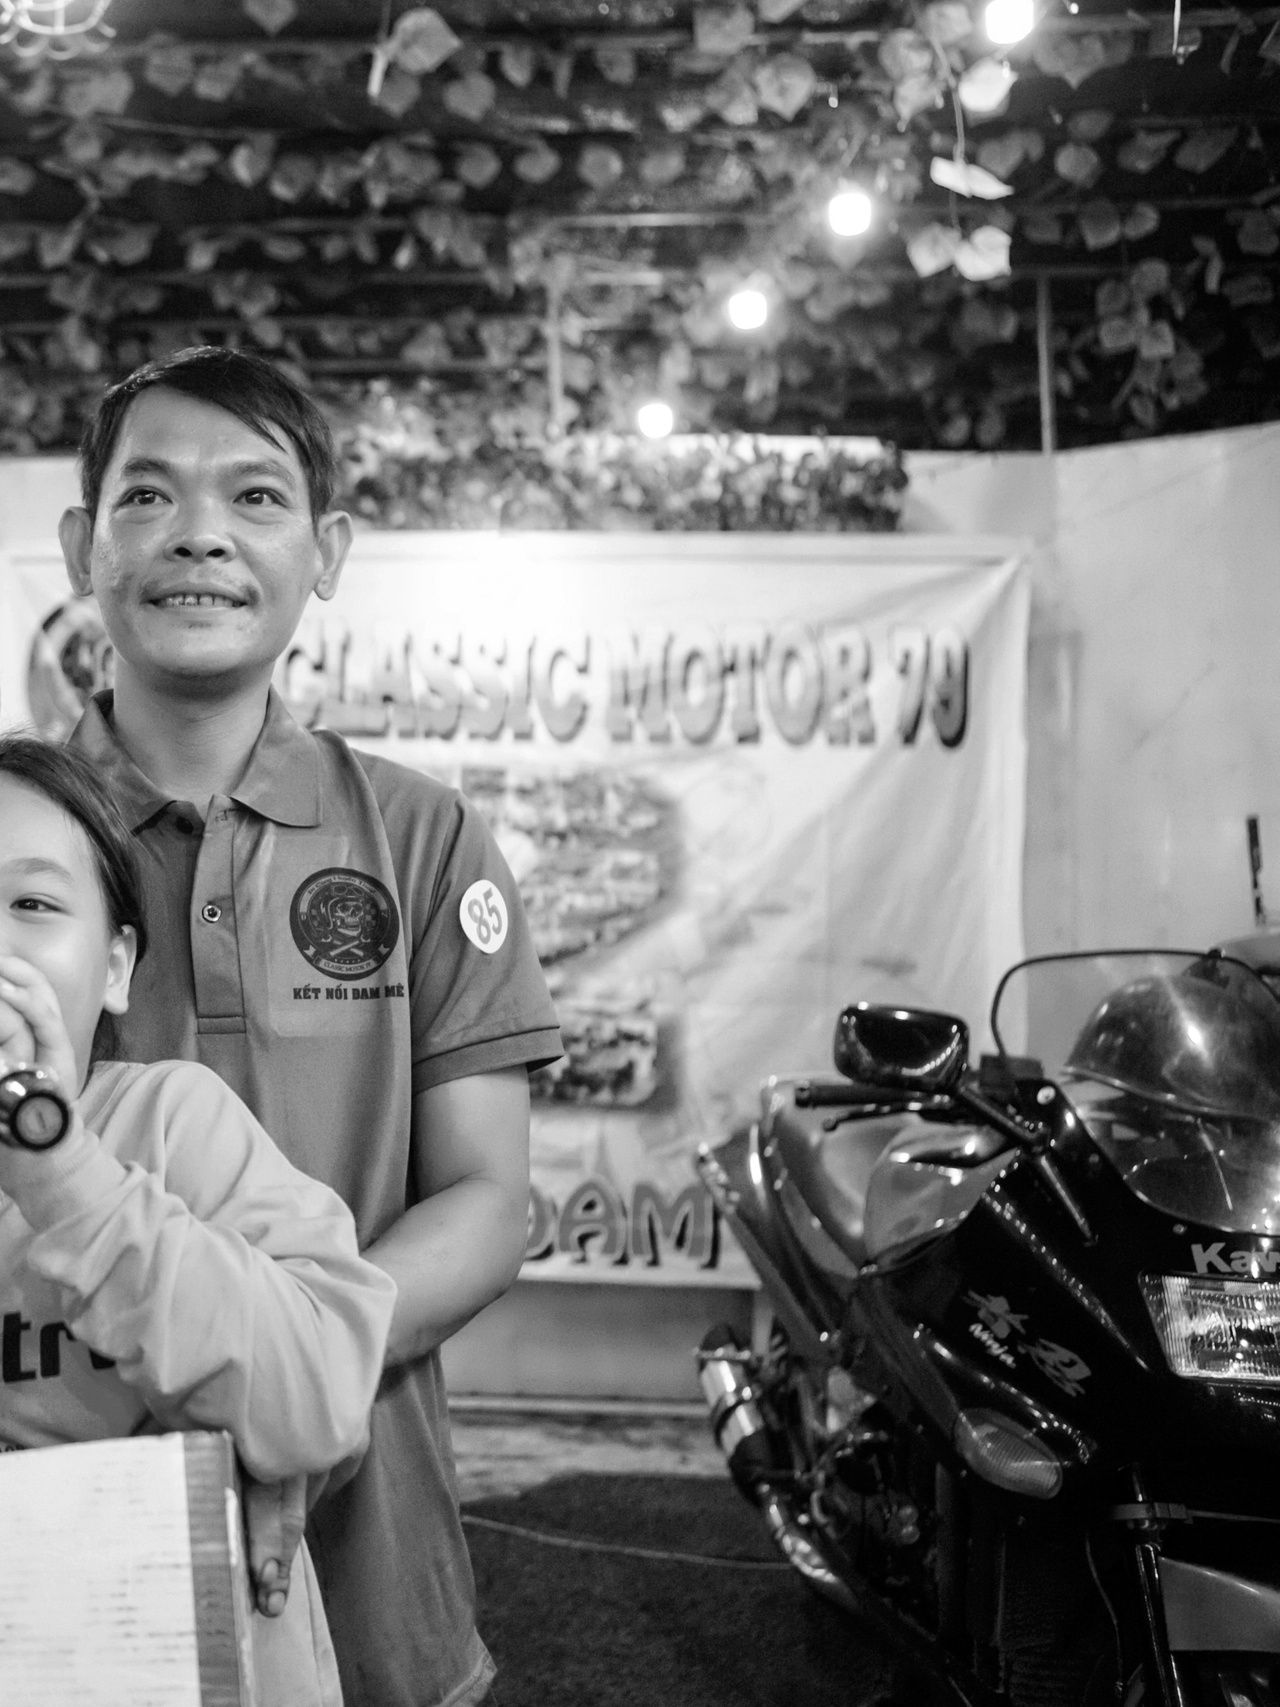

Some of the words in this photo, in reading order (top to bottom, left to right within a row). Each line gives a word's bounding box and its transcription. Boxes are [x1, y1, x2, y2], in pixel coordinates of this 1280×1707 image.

[275, 617, 593, 744] CLASSIC
[606, 619, 876, 749] MOTOR
[888, 621, 973, 750] 79
[467, 887, 503, 945] 85
[293, 983, 321, 1000] KẾT
[325, 983, 348, 1000] NỐI
[384, 981, 404, 998] MÊ
